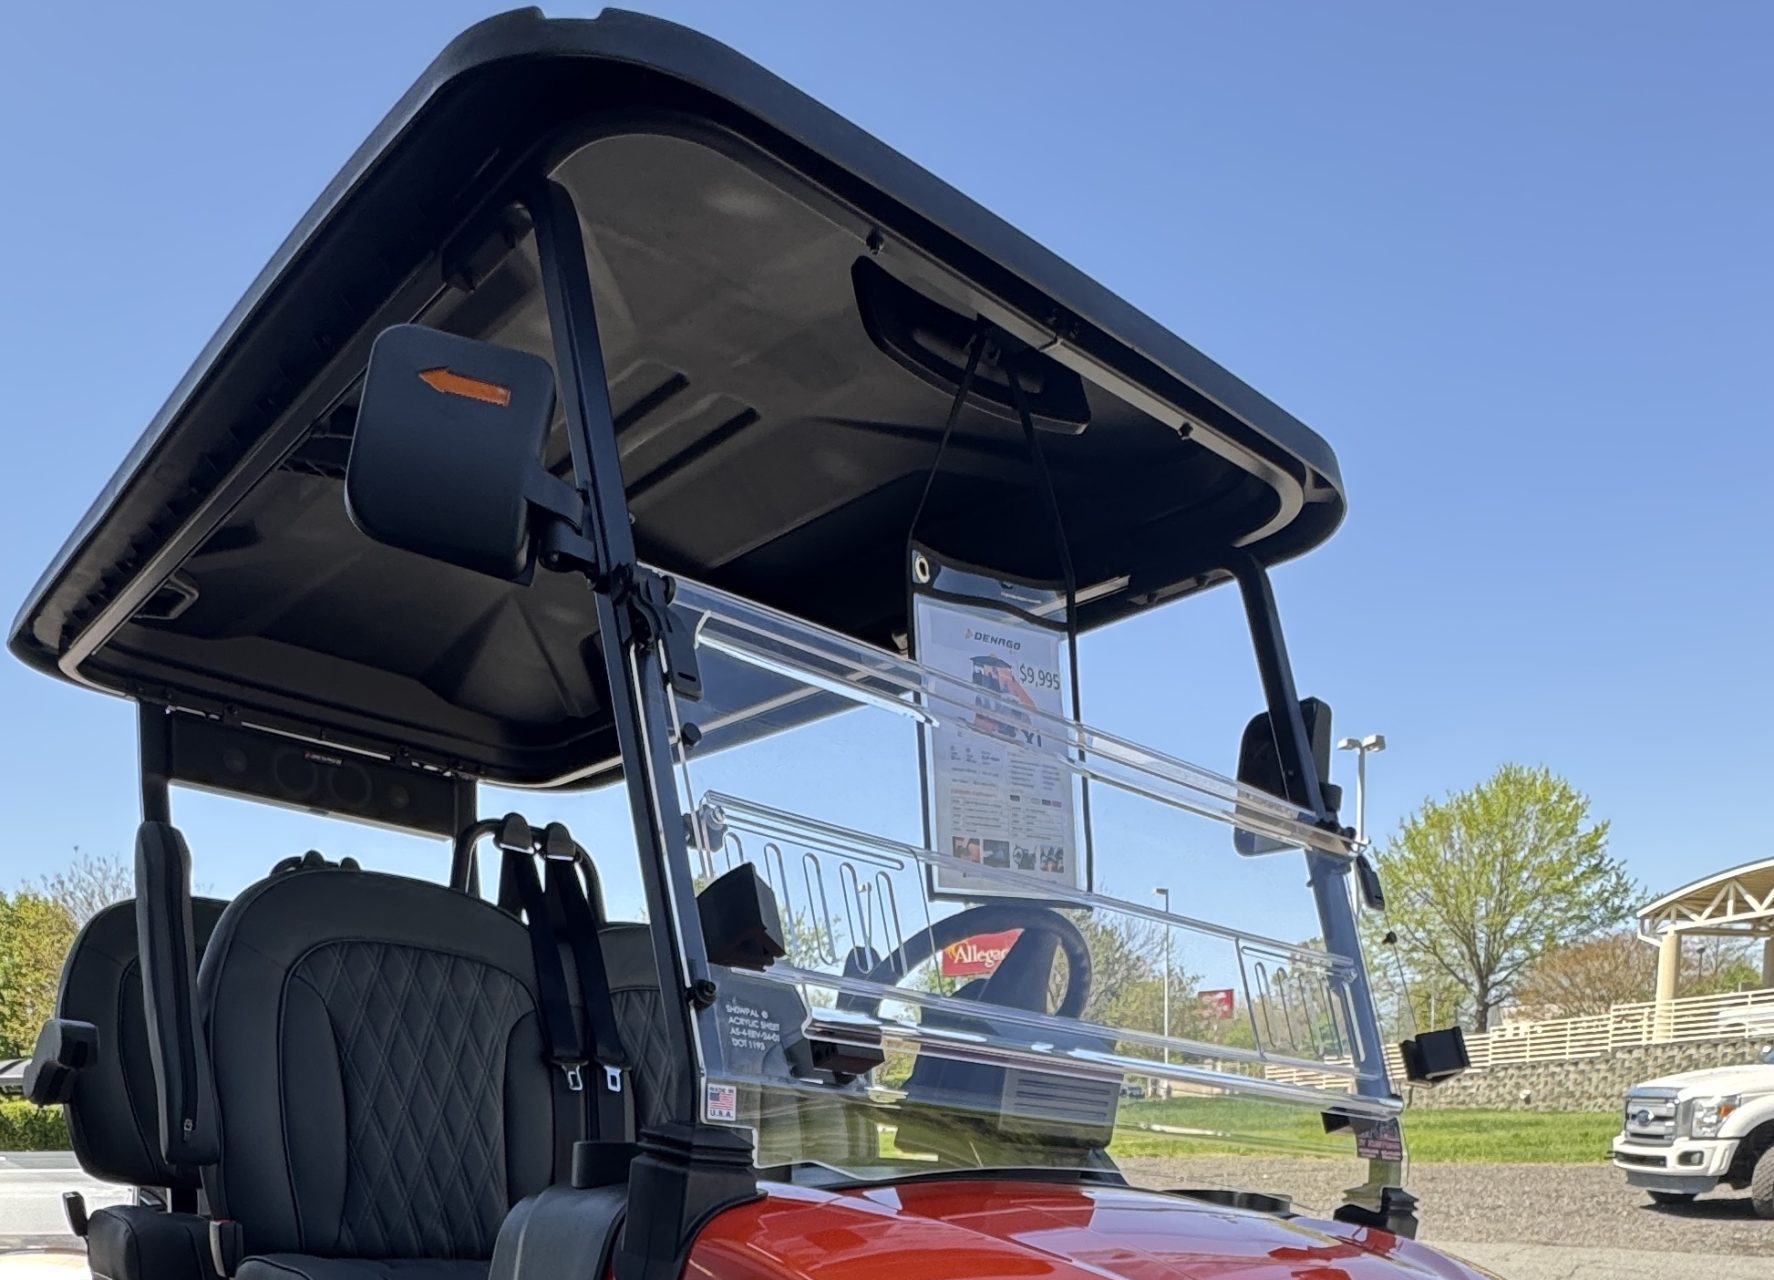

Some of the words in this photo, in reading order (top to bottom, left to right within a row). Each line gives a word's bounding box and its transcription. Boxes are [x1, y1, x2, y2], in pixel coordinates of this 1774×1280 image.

[974, 631, 1021, 651] DENAGO
[1019, 663, 1061, 691] $9,995
[728, 1016, 760, 1028] ACRYLIC
